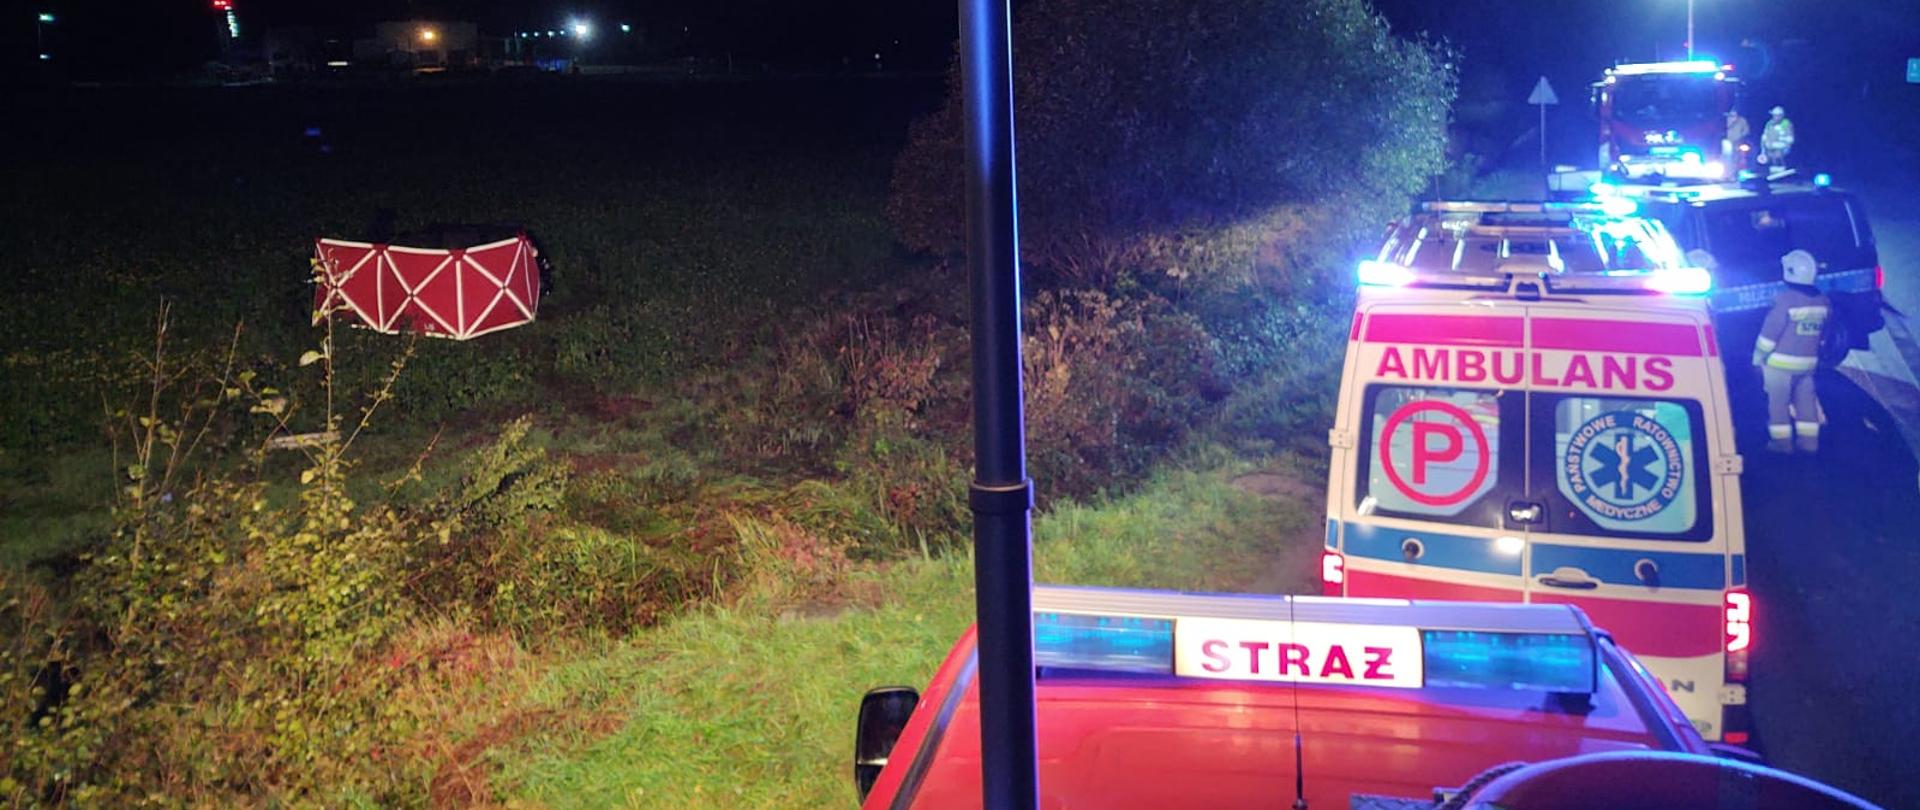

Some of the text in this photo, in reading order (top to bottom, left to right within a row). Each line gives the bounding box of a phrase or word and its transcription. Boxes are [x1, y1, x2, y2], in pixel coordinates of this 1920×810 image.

[1375, 346, 1674, 391] AMBULANS
[1413, 422, 1463, 485] P
[1633, 416, 1681, 499] RATOWNICTWO
[1586, 495, 1662, 519] MEDYCZNE
